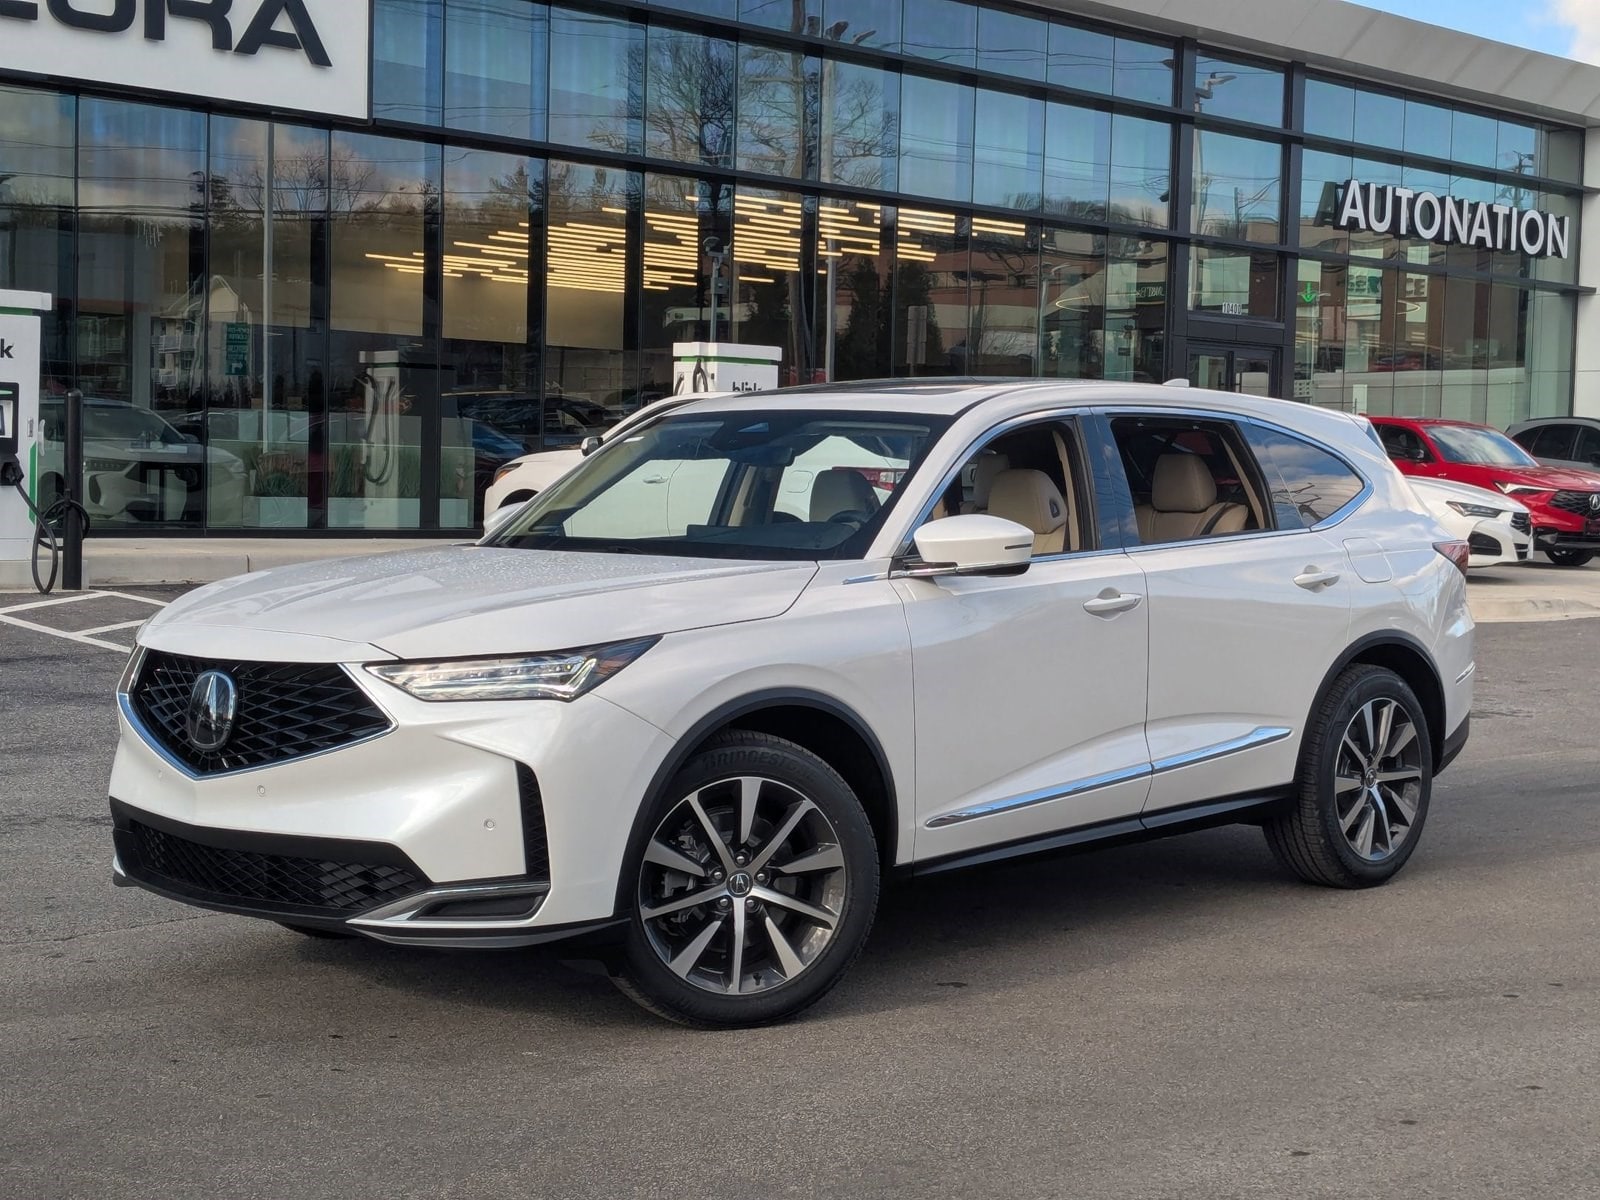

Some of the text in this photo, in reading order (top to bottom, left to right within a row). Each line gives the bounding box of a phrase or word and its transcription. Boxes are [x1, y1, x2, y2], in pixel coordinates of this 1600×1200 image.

[0, 0, 333, 67] URA
[1339, 179, 1570, 259] AUTONATION
[1222, 302, 1242, 315] 10400
